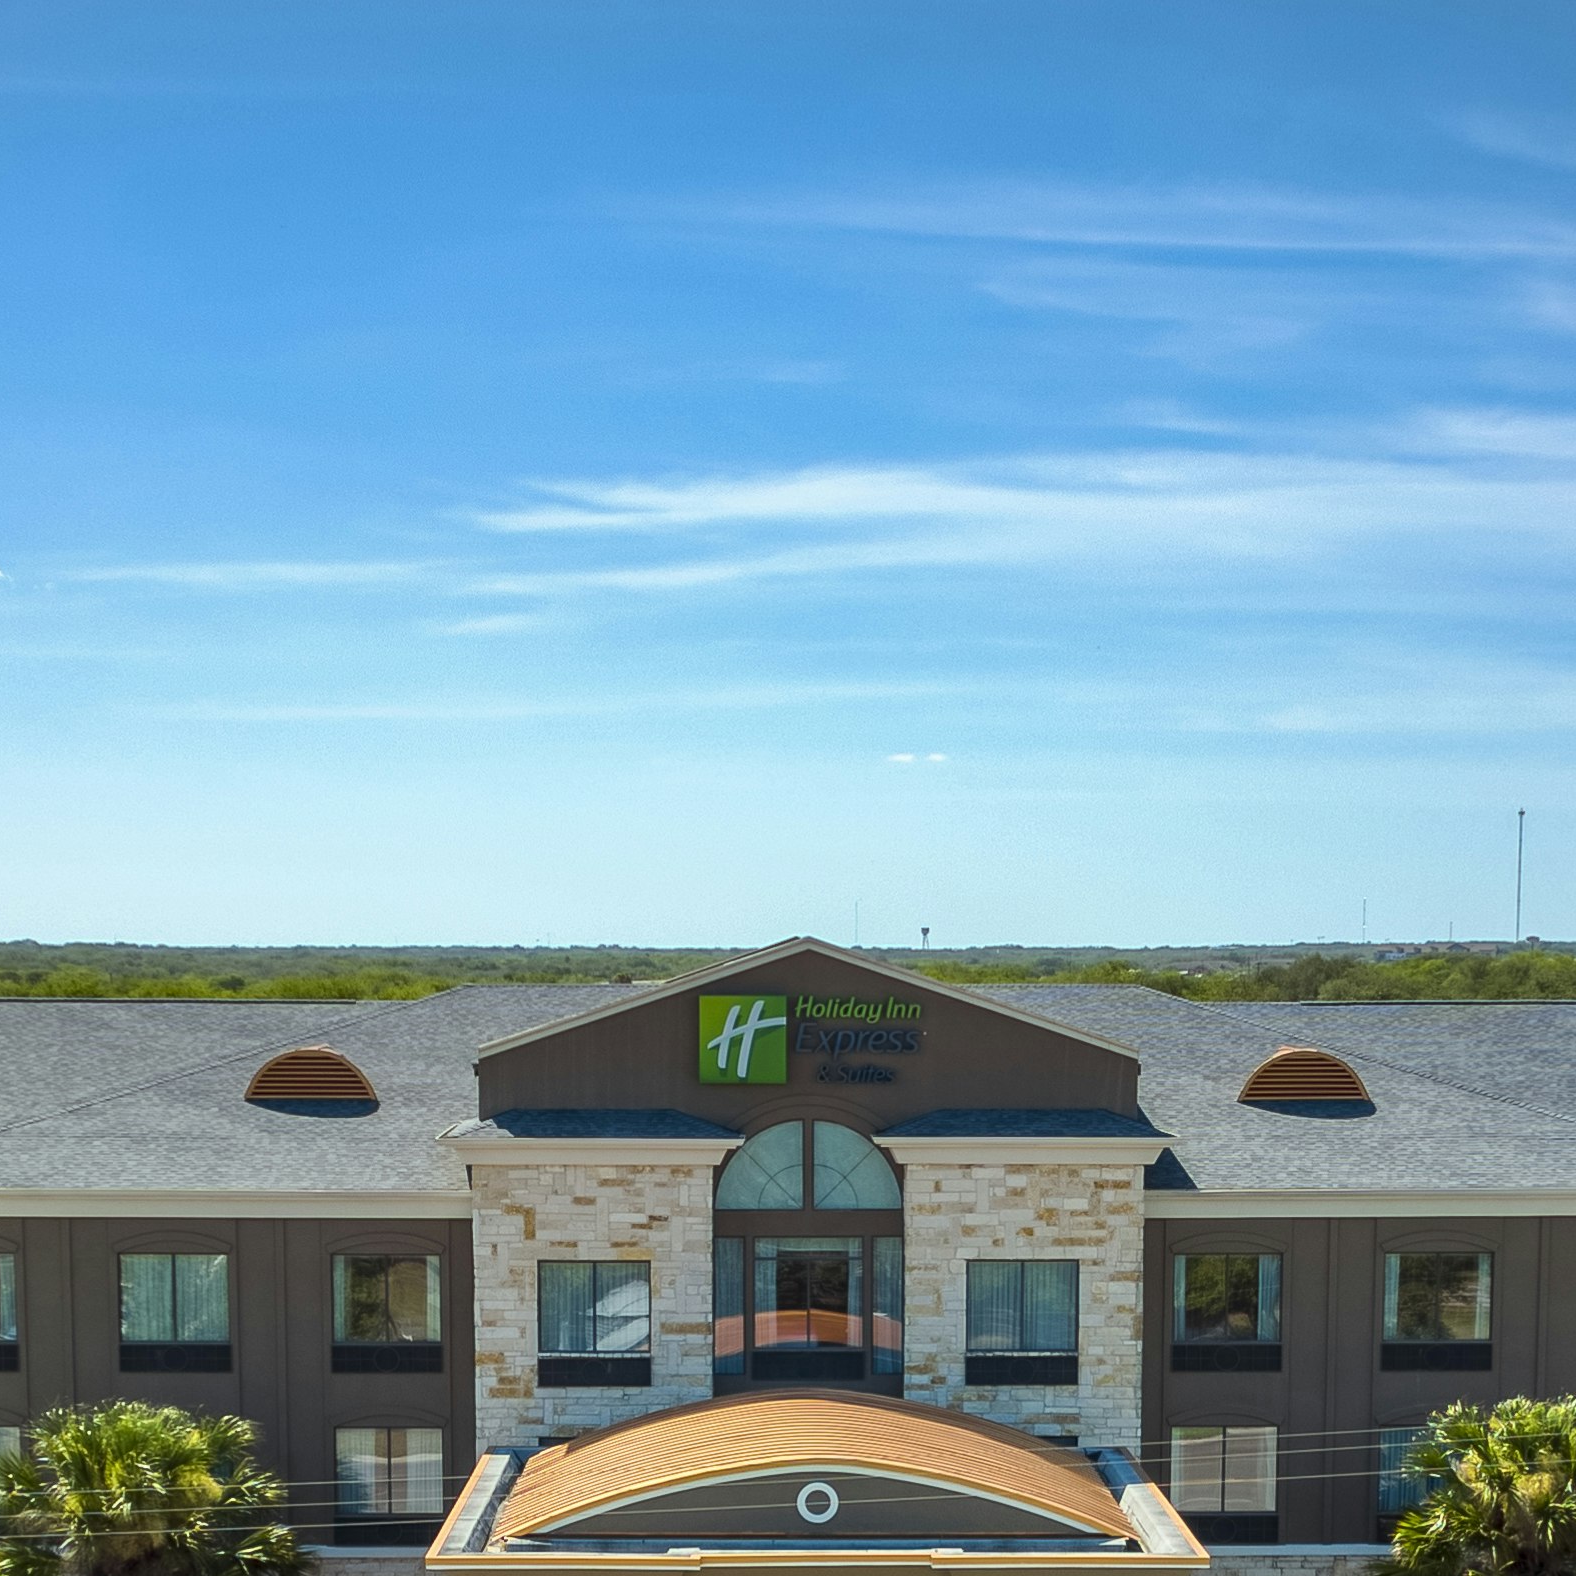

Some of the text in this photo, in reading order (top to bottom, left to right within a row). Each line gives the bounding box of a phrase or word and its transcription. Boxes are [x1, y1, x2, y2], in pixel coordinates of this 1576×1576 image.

[795, 995, 922, 1024] Holiday Inn
[795, 1022, 921, 1060] Express
[817, 1063, 896, 1084] & Suites
